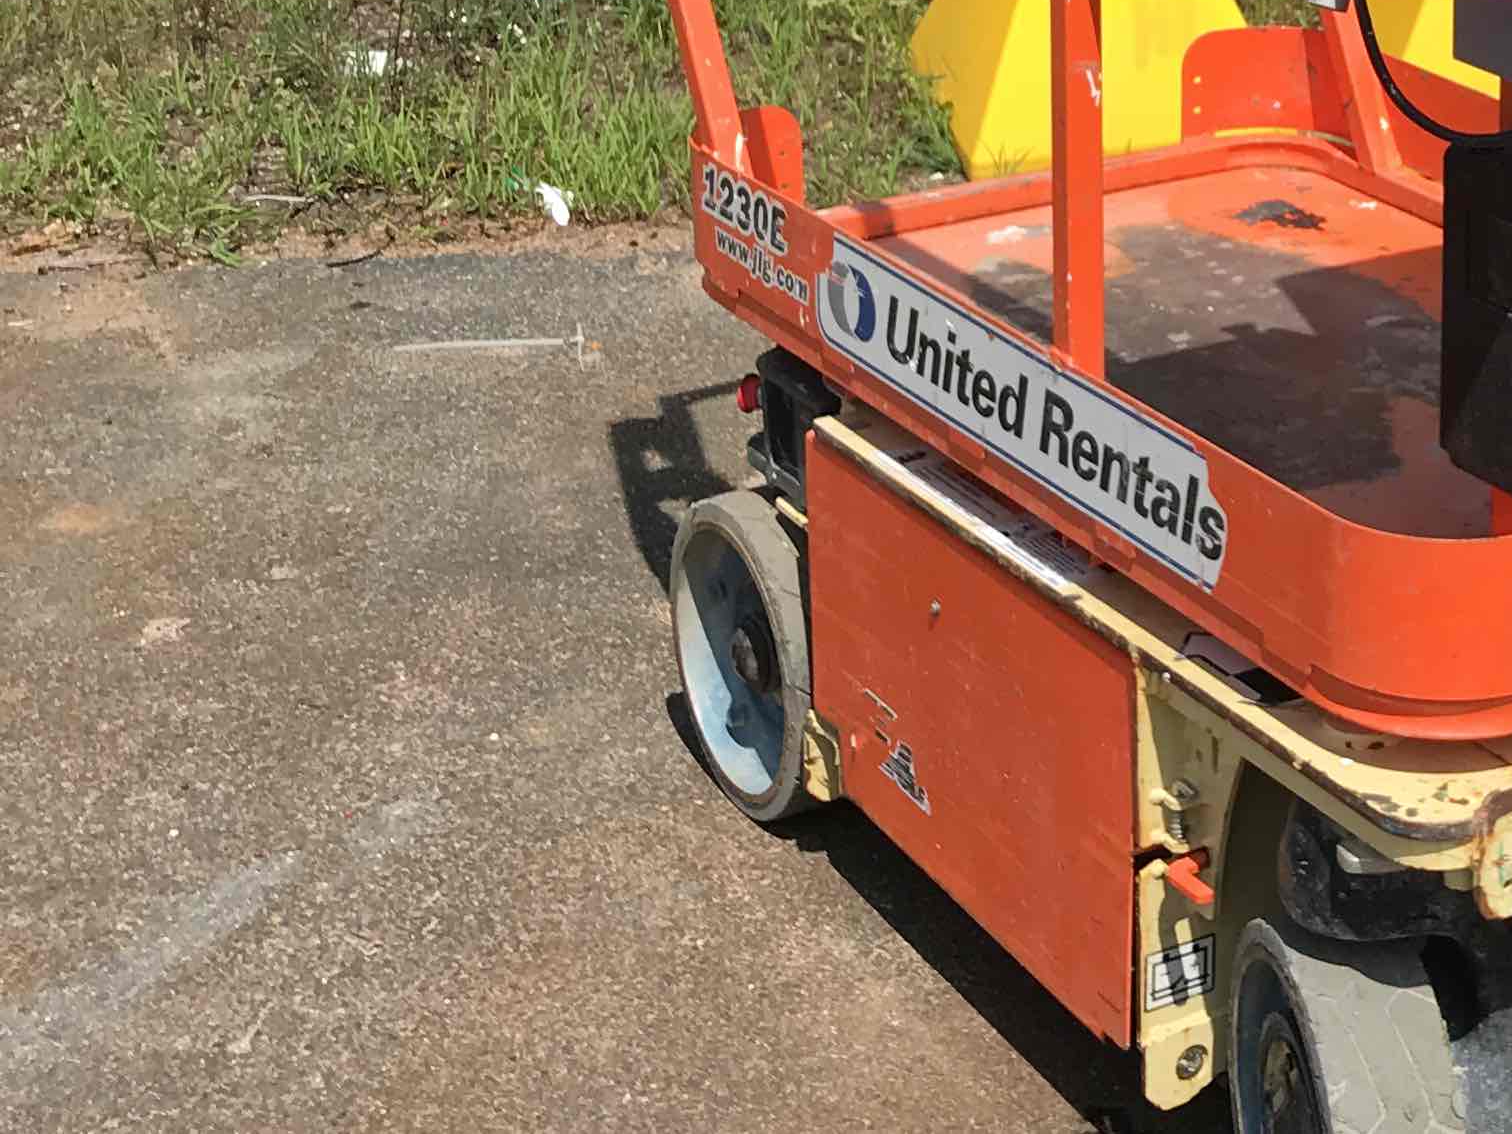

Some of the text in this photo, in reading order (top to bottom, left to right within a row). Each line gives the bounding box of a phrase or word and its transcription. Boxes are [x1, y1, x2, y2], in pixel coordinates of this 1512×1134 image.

[703, 165, 788, 254] 1230E
[715, 227, 808, 304] www.jlg.com
[886, 297, 1226, 562] United Rentals
